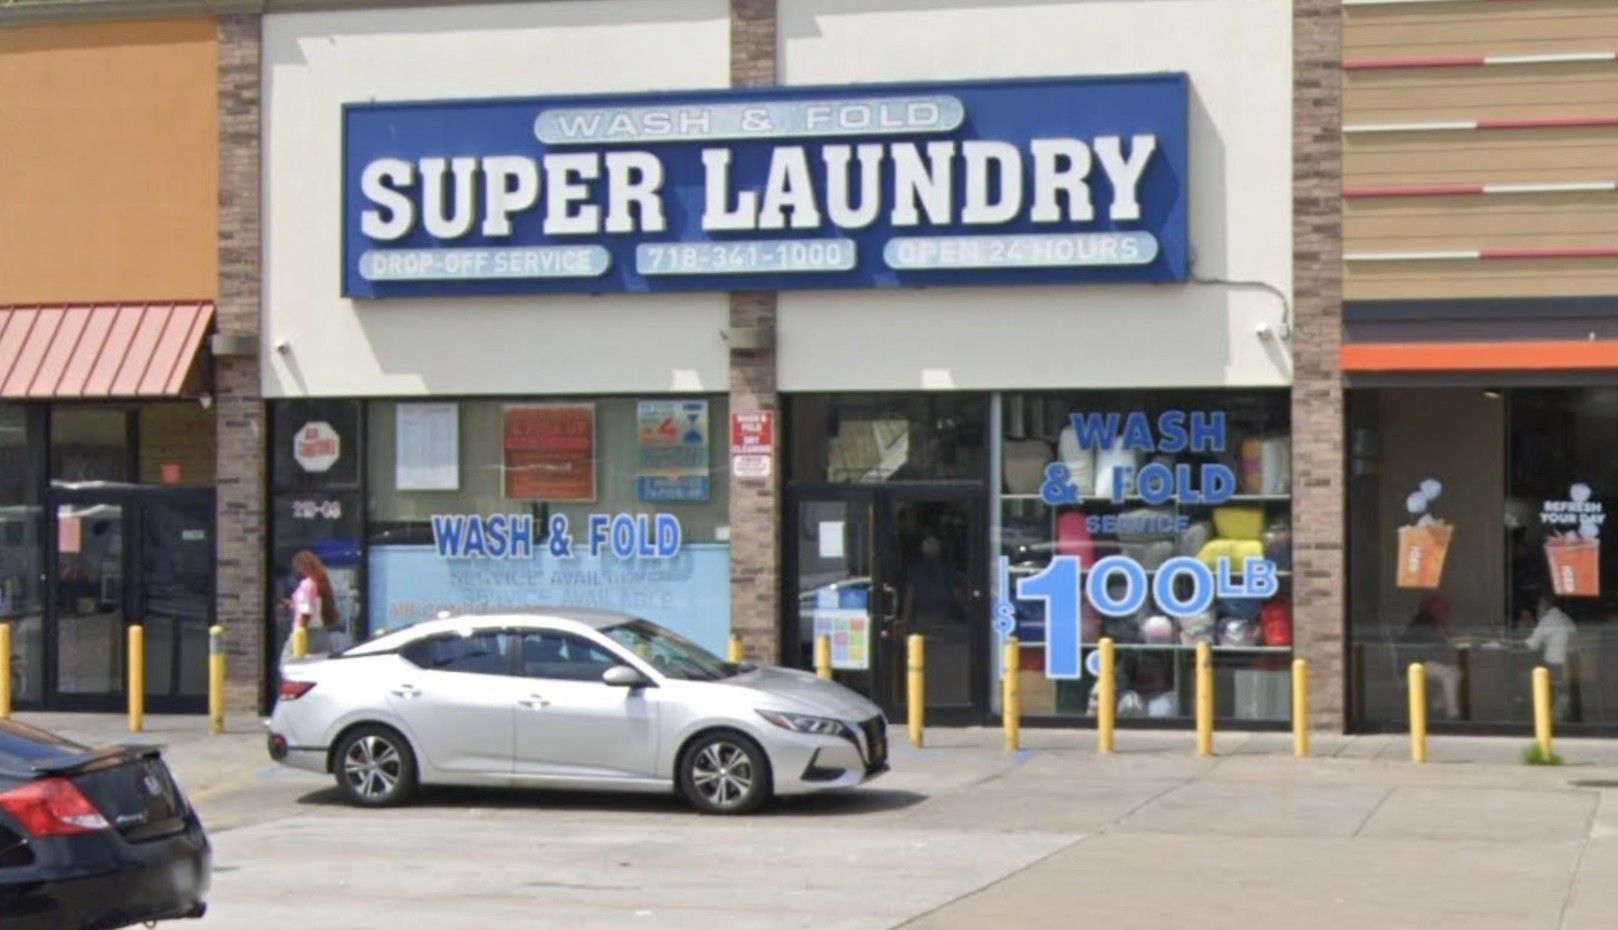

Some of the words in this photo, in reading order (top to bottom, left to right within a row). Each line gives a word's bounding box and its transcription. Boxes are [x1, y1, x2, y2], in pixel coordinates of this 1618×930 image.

[559, 109, 710, 138] WASH
[741, 108, 773, 131] &
[806, 102, 939, 129] FOLD
[361, 151, 667, 240] SUPER
[702, 134, 1157, 230] LAUNDRY
[373, 251, 488, 276] DROP-OFF
[494, 248, 591, 272] SERVICE
[648, 241, 842, 269] 718-341-1000
[898, 239, 979, 264] OPEN
[989, 239, 1022, 262] 24
[1034, 236, 1139, 261] HOURS
[1069, 410, 1226, 452] WASH
[1040, 462, 1084, 505] &
[1112, 462, 1236, 505] FOLD
[1540, 512, 1577, 524] YOUR
[1579, 513, 1606, 524] DAY
[1543, 501, 1602, 512] REFRESH
[430, 514, 533, 558] WASH
[550, 513, 574, 558] &
[589, 513, 682, 558] FOLD
[1086, 514, 1190, 534] SERVICE
